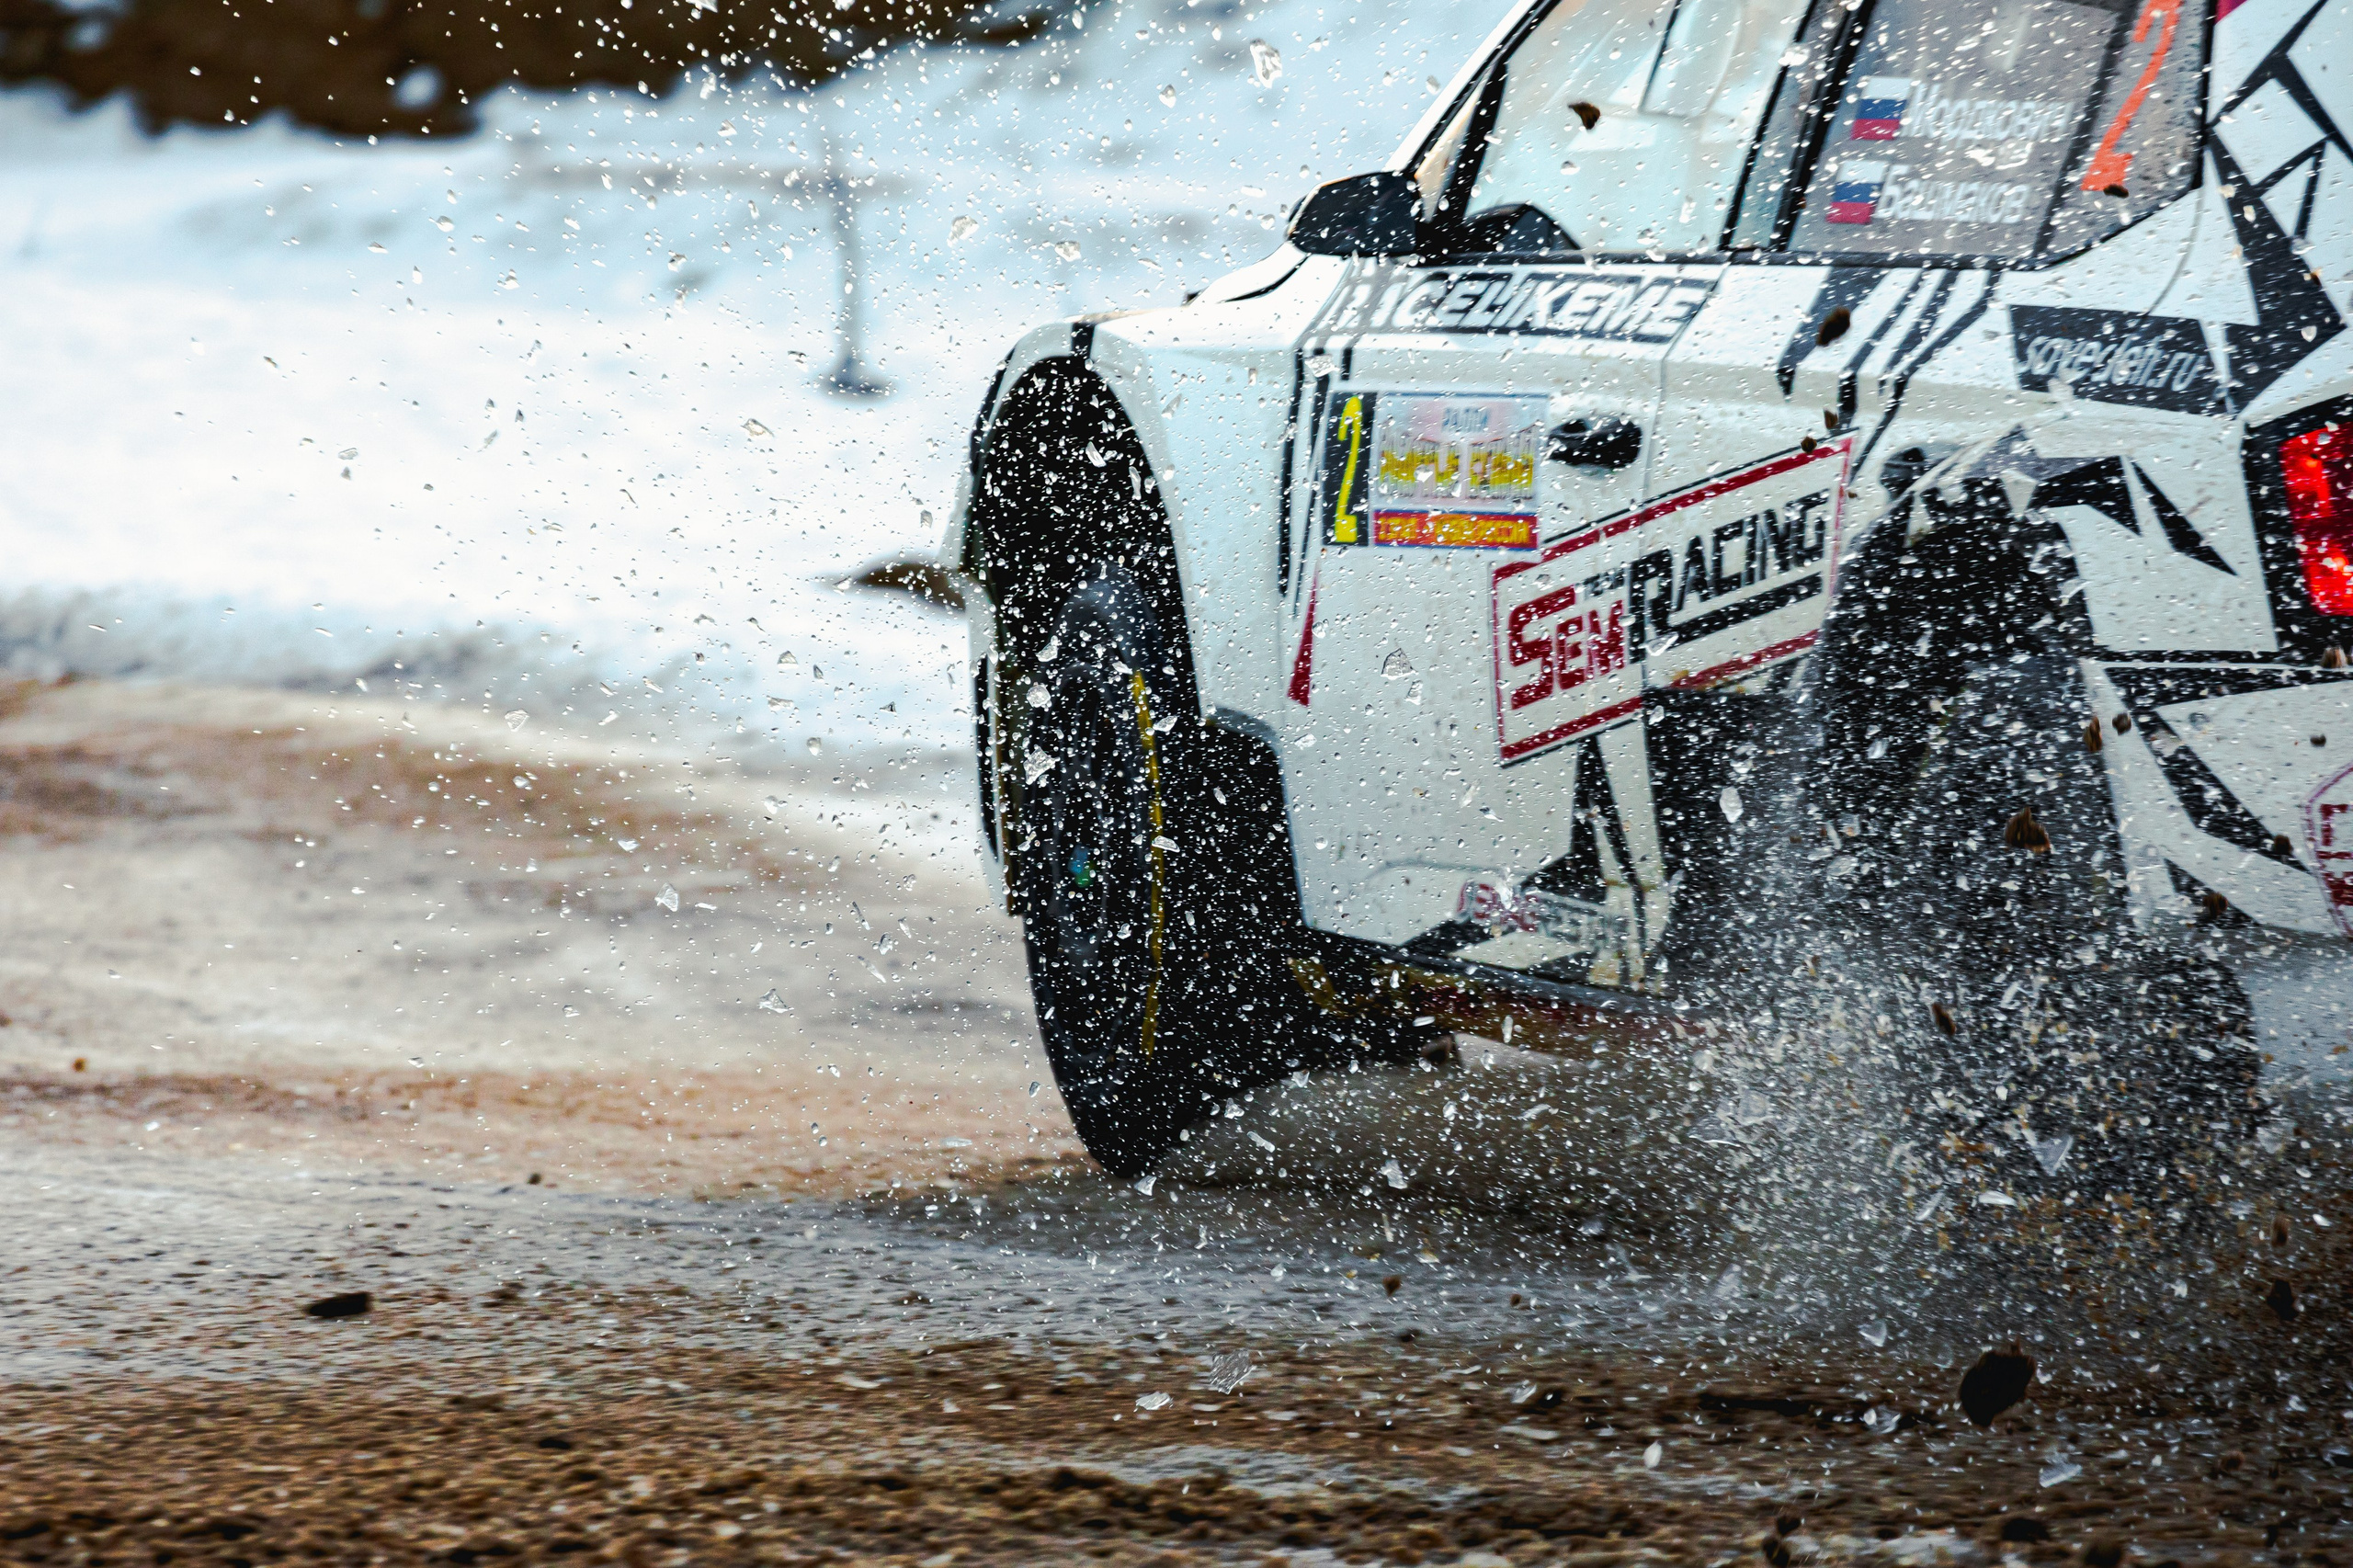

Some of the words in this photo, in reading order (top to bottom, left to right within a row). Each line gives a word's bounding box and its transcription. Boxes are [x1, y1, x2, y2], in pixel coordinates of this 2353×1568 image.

[2080, 0, 2184, 191] 2
[1335, 395, 1363, 543] 2
[1629, 488, 1831, 664] RACING
